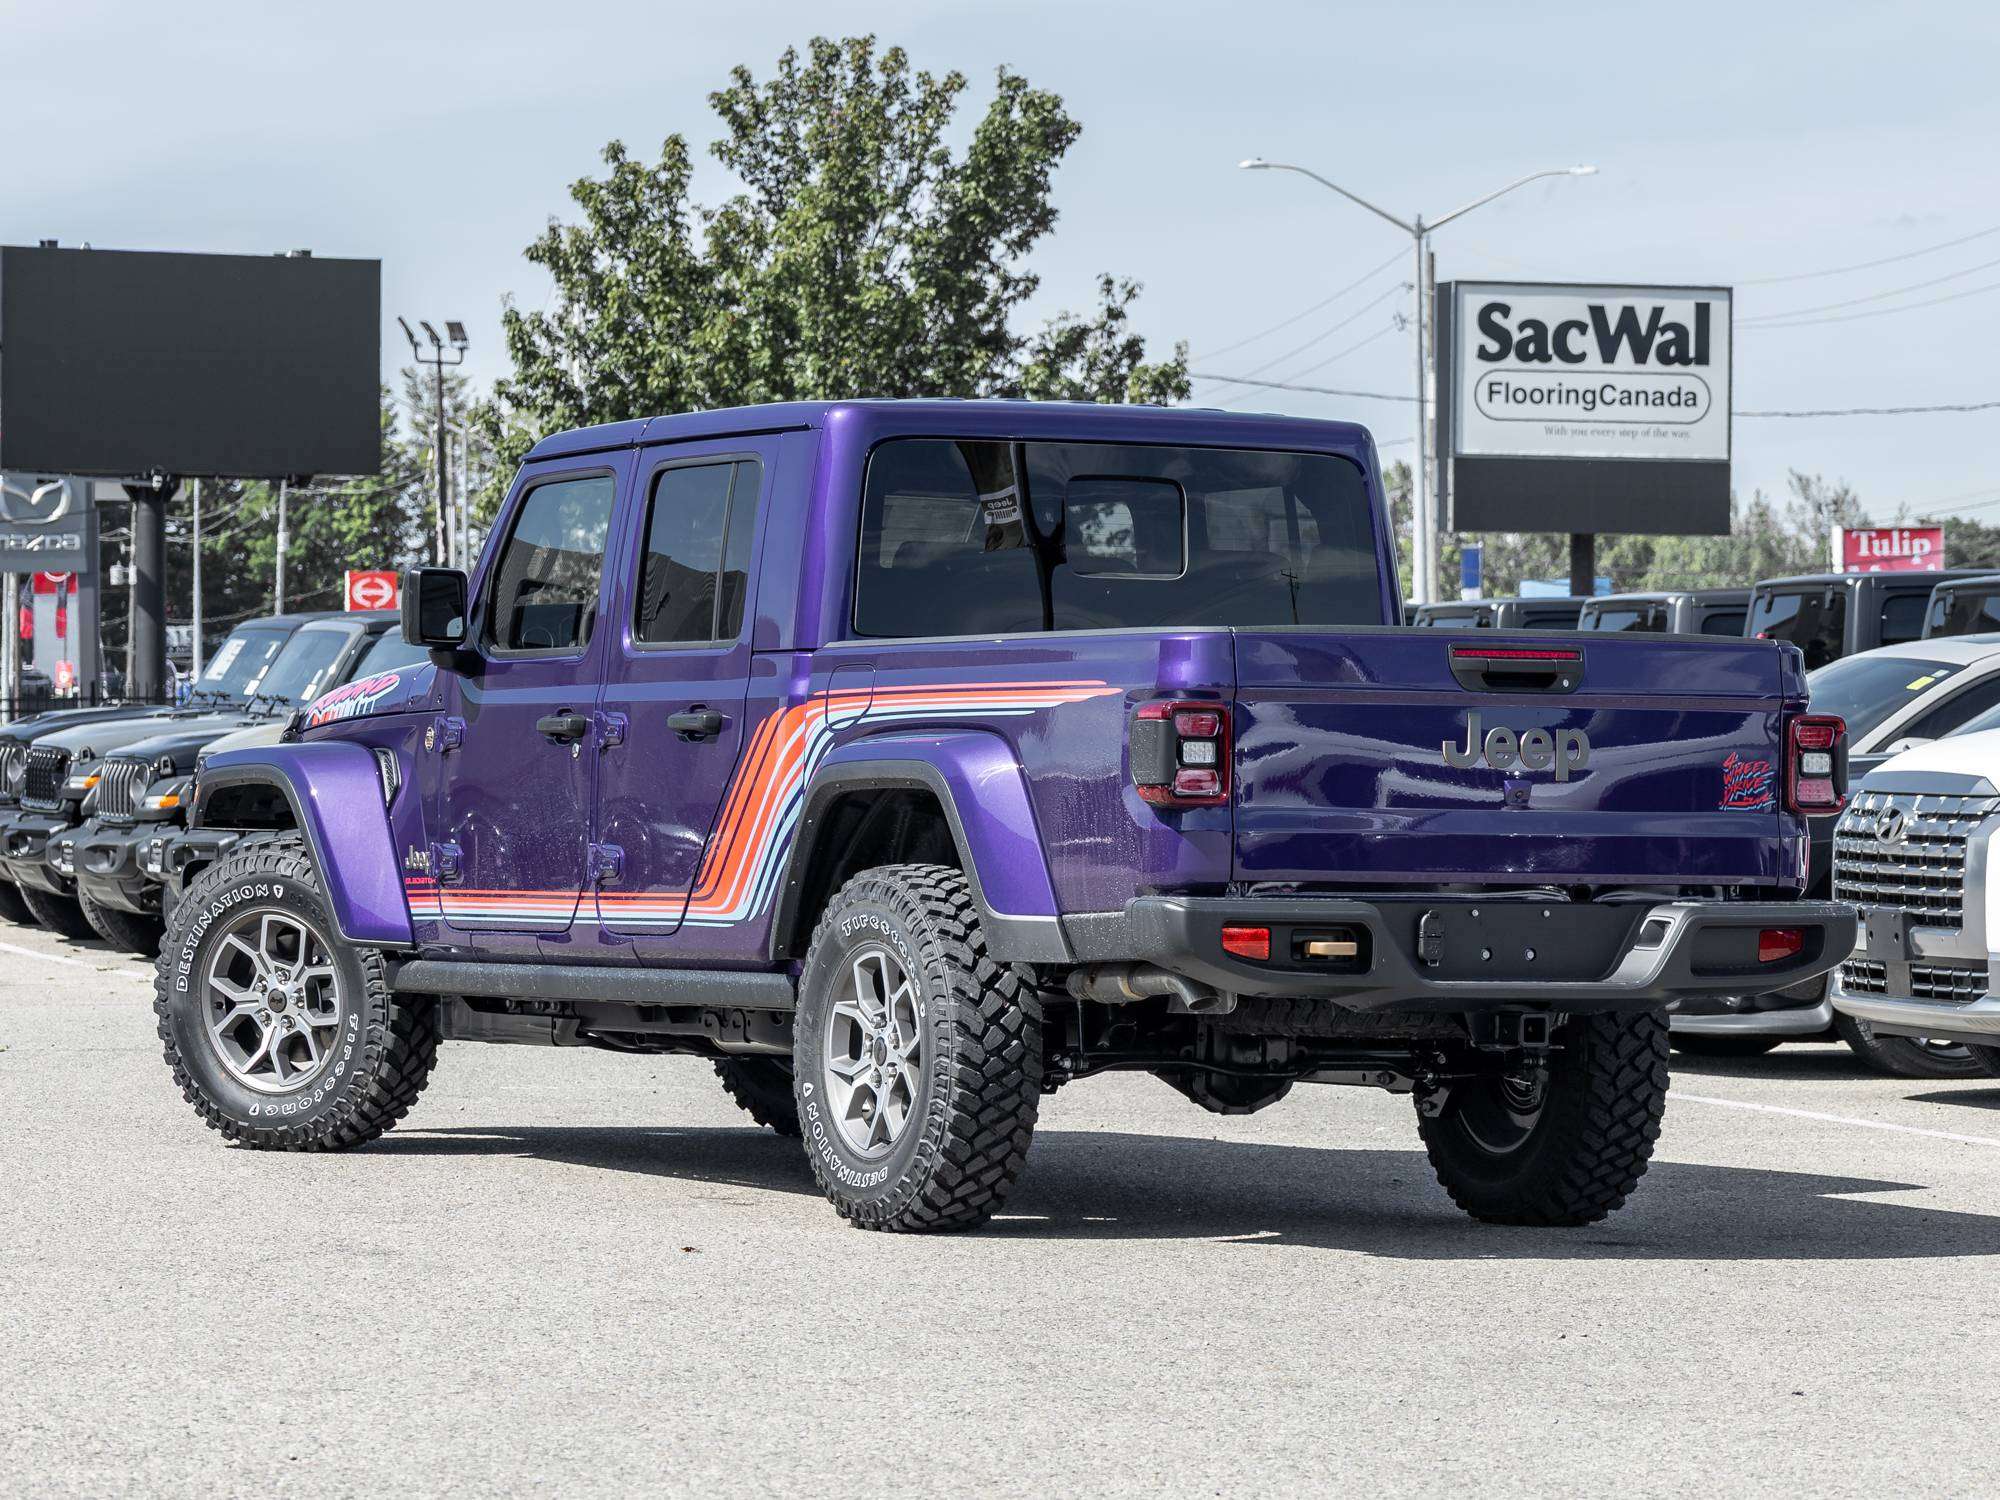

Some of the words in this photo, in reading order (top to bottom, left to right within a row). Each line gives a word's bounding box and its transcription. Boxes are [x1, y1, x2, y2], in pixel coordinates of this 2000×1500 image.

[1477, 302, 1710, 366] SacWal
[1488, 382, 1698, 411] FlooringCanada
[1544, 425, 1567, 437] With
[1571, 428, 1588, 438] you
[1590, 428, 1616, 439] every
[1619, 428, 1638, 440] step
[1641, 427, 1651, 437] of
[1652, 427, 1668, 438] the
[1851, 530, 1932, 564] Tulip
[1442, 712, 1591, 782] Jeep
[176, 883, 269, 993] DESTINATION
[806, 1101, 889, 1188] DESTINATION
